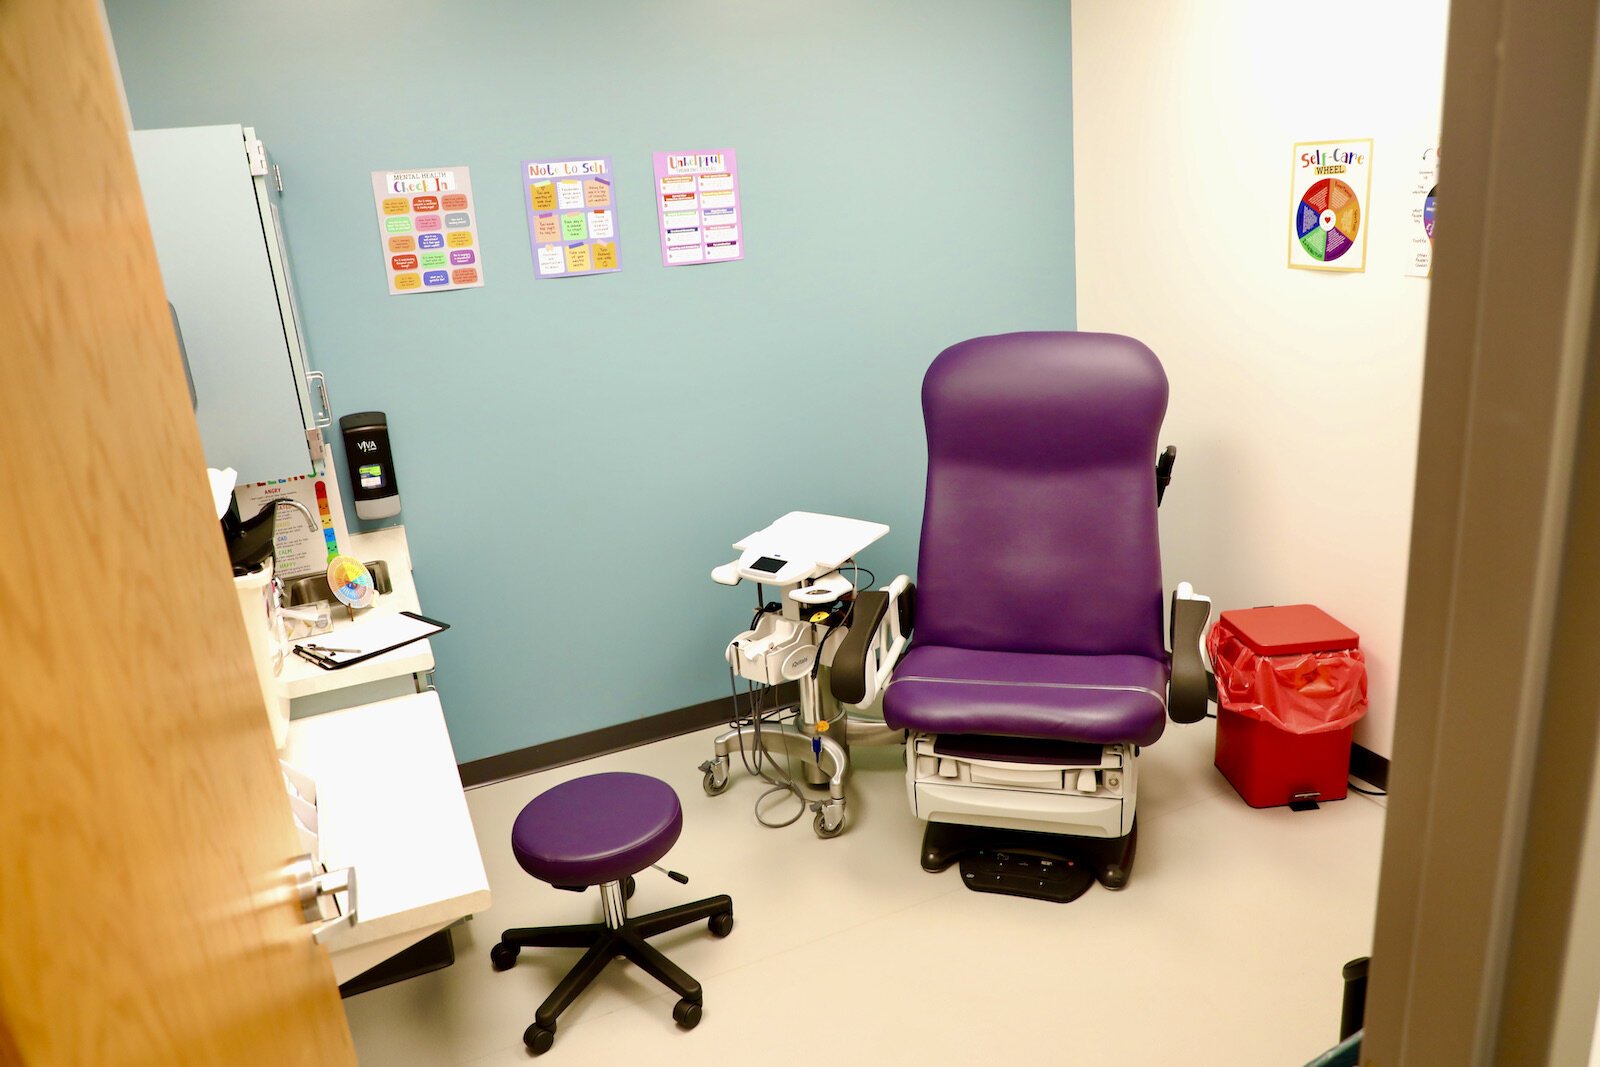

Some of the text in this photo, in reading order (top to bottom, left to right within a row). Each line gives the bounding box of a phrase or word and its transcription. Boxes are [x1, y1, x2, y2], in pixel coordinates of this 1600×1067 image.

[1301, 148, 1364, 168] Self-Care
[529, 164, 559, 176] Note
[564, 163, 578, 175] to
[1316, 165, 1345, 175] WHEEL
[393, 178, 448, 193] Check In
[357, 440, 377, 452] VIVA
